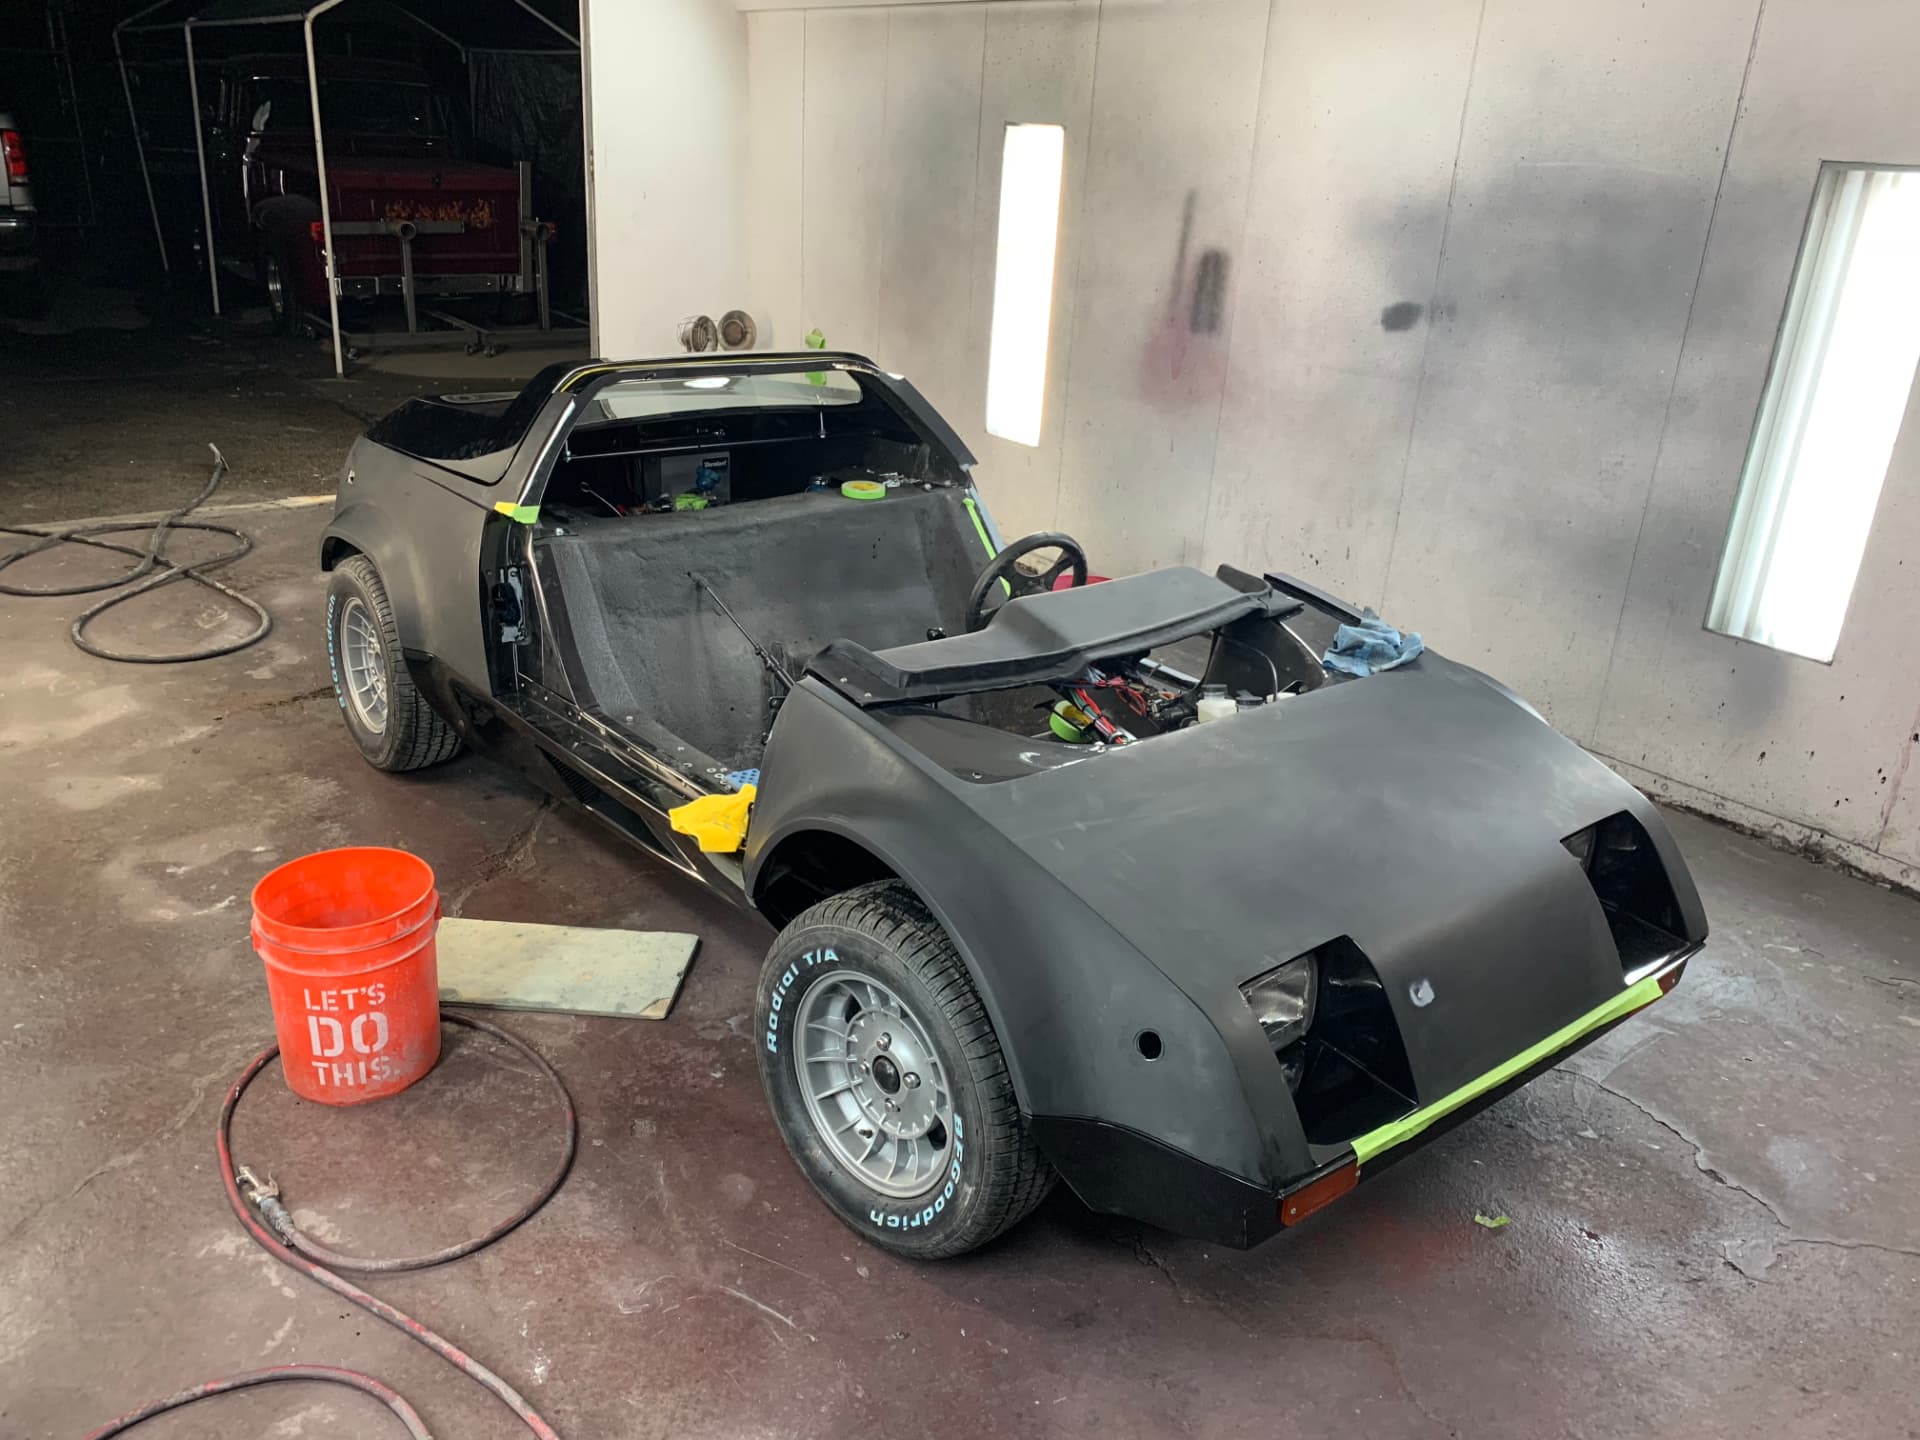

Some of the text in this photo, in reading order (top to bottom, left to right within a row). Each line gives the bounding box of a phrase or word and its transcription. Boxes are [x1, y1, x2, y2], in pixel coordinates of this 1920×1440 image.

[304, 983, 386, 1010] LET'S
[767, 948, 840, 1053] Radial T/A
[307, 1012, 389, 1056] DO
[869, 1113, 963, 1231] BFGoodrich
